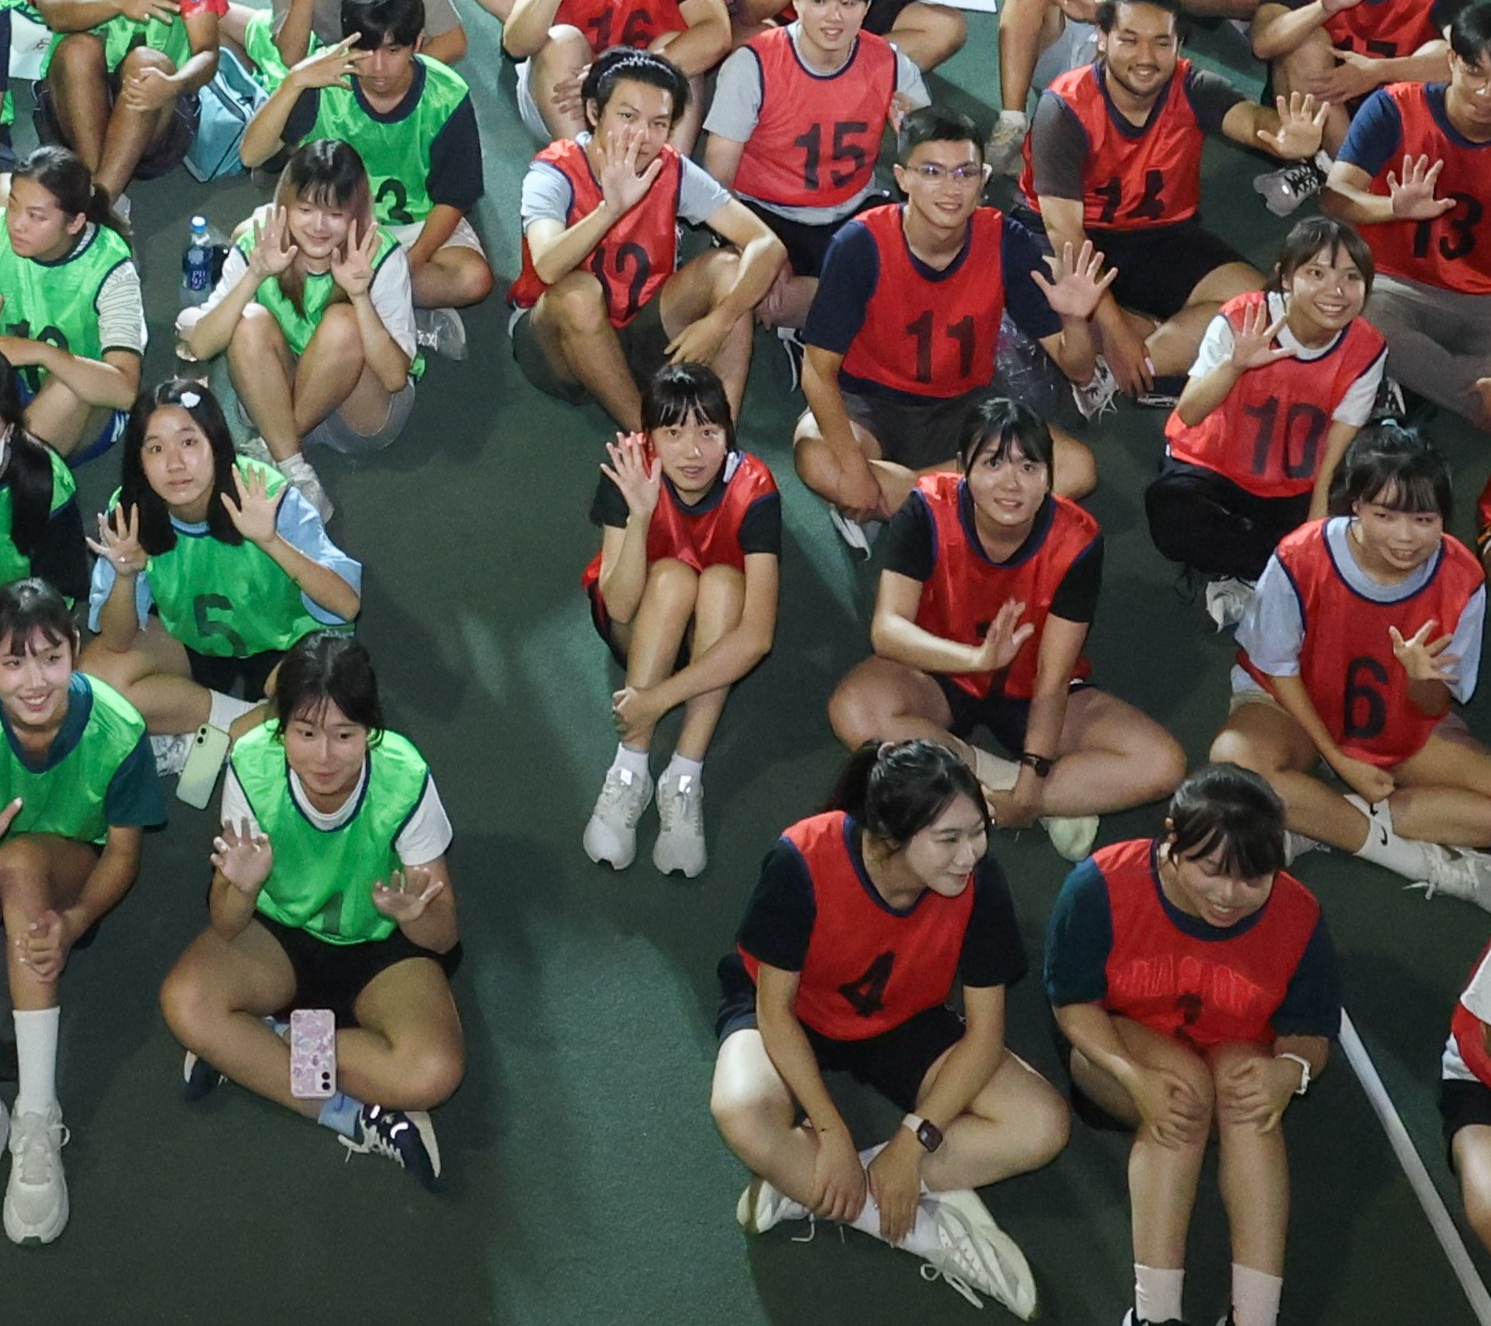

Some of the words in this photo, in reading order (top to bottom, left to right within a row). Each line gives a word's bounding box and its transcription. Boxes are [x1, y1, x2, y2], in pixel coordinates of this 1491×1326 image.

[587, 7, 654, 51] 16
[795, 122, 869, 190] 15
[1096, 169, 1166, 224] 14
[1413, 192, 1484, 261] 13
[906, 311, 976, 384] 11
[1244, 395, 1329, 478] 10
[193, 594, 247, 660] 5
[1344, 656, 1389, 739] 6
[836, 951, 896, 1017] 4
